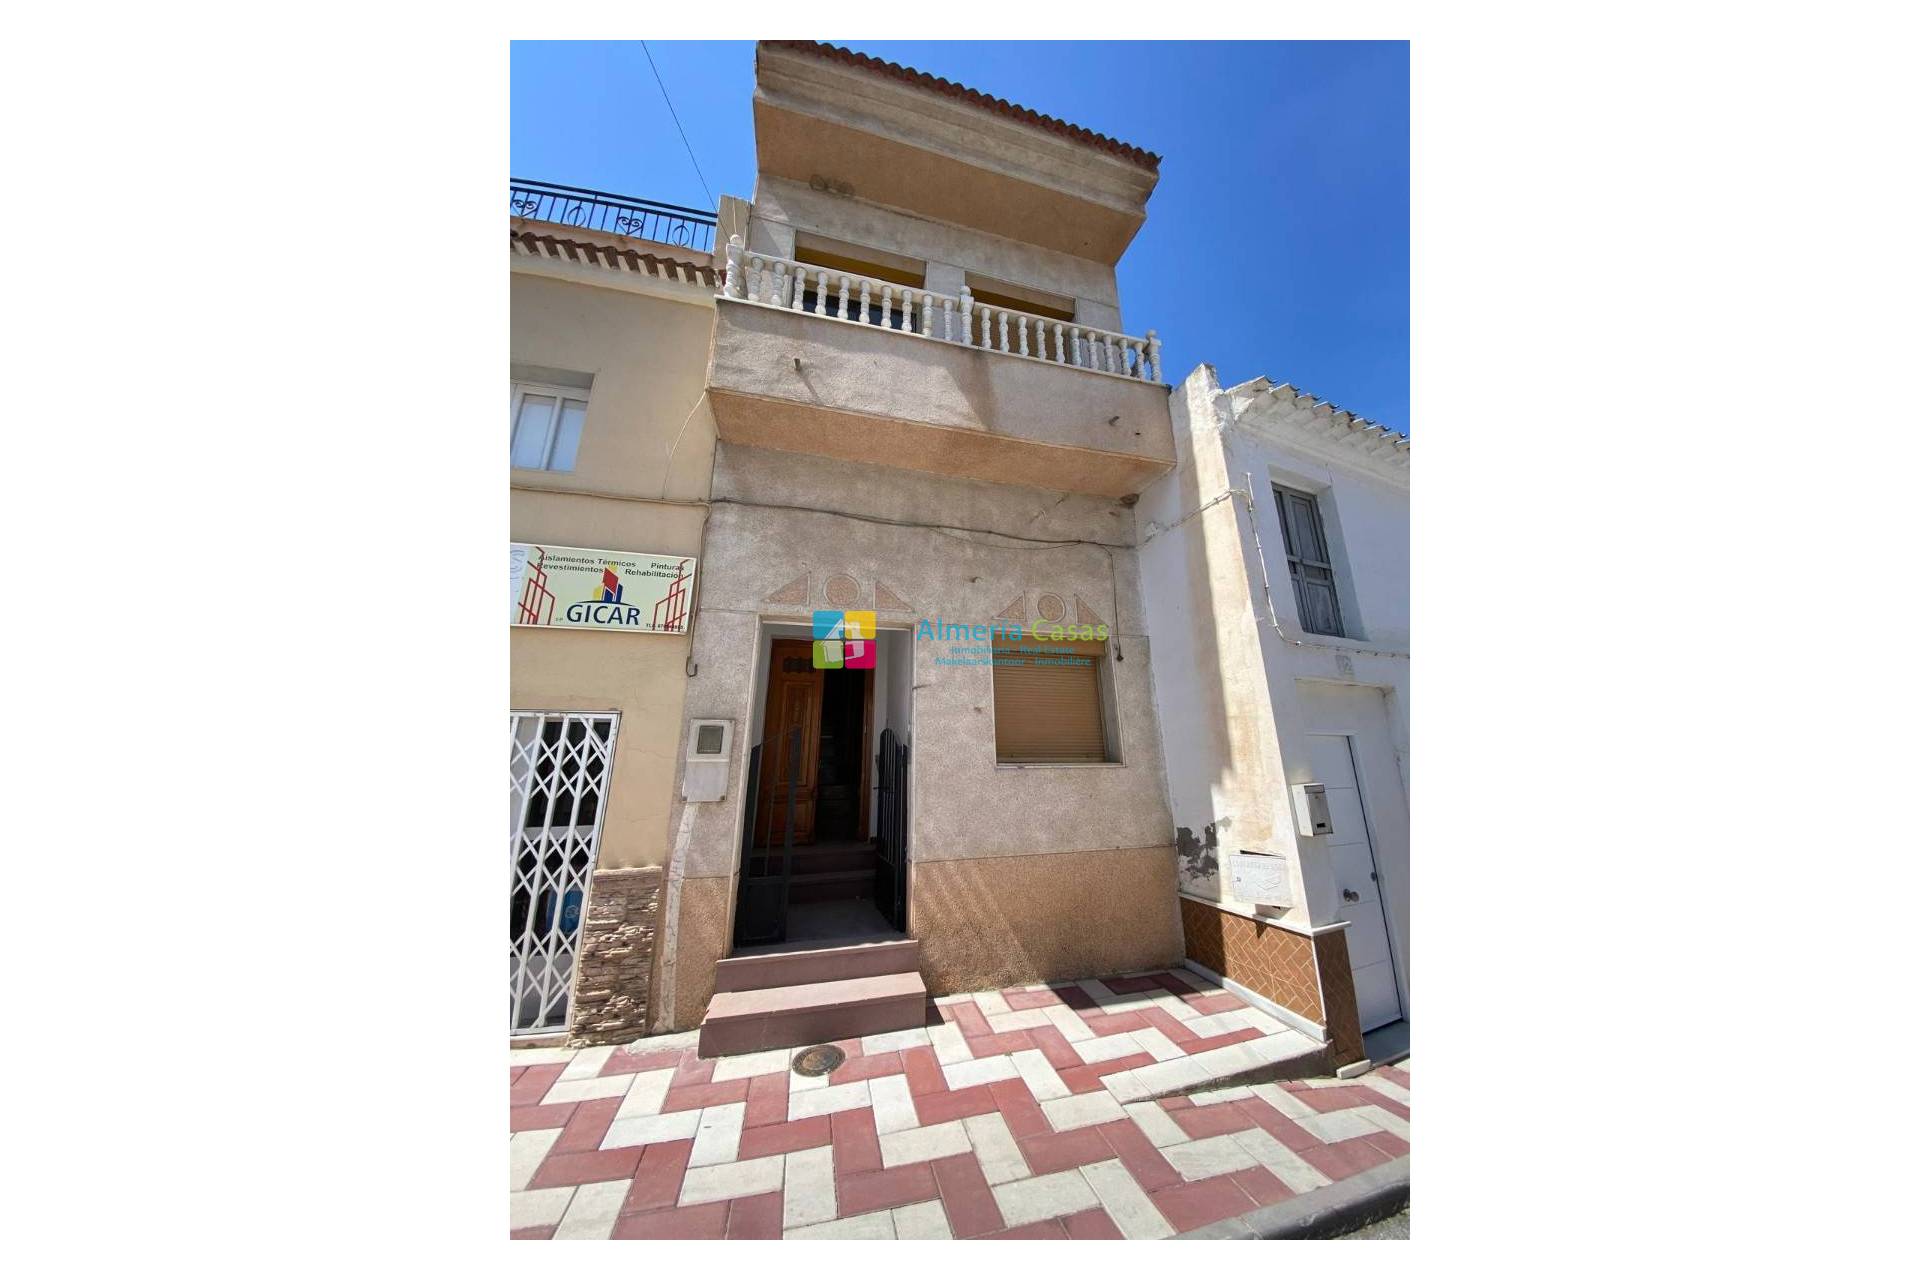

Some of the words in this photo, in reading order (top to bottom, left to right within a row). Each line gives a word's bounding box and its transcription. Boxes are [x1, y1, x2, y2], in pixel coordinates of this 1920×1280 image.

[537, 563, 603, 574] Revestimientos
[538, 555, 595, 565] Aislamientos
[651, 562, 684, 571] Pinturas
[566, 604, 641, 626] GICAR
